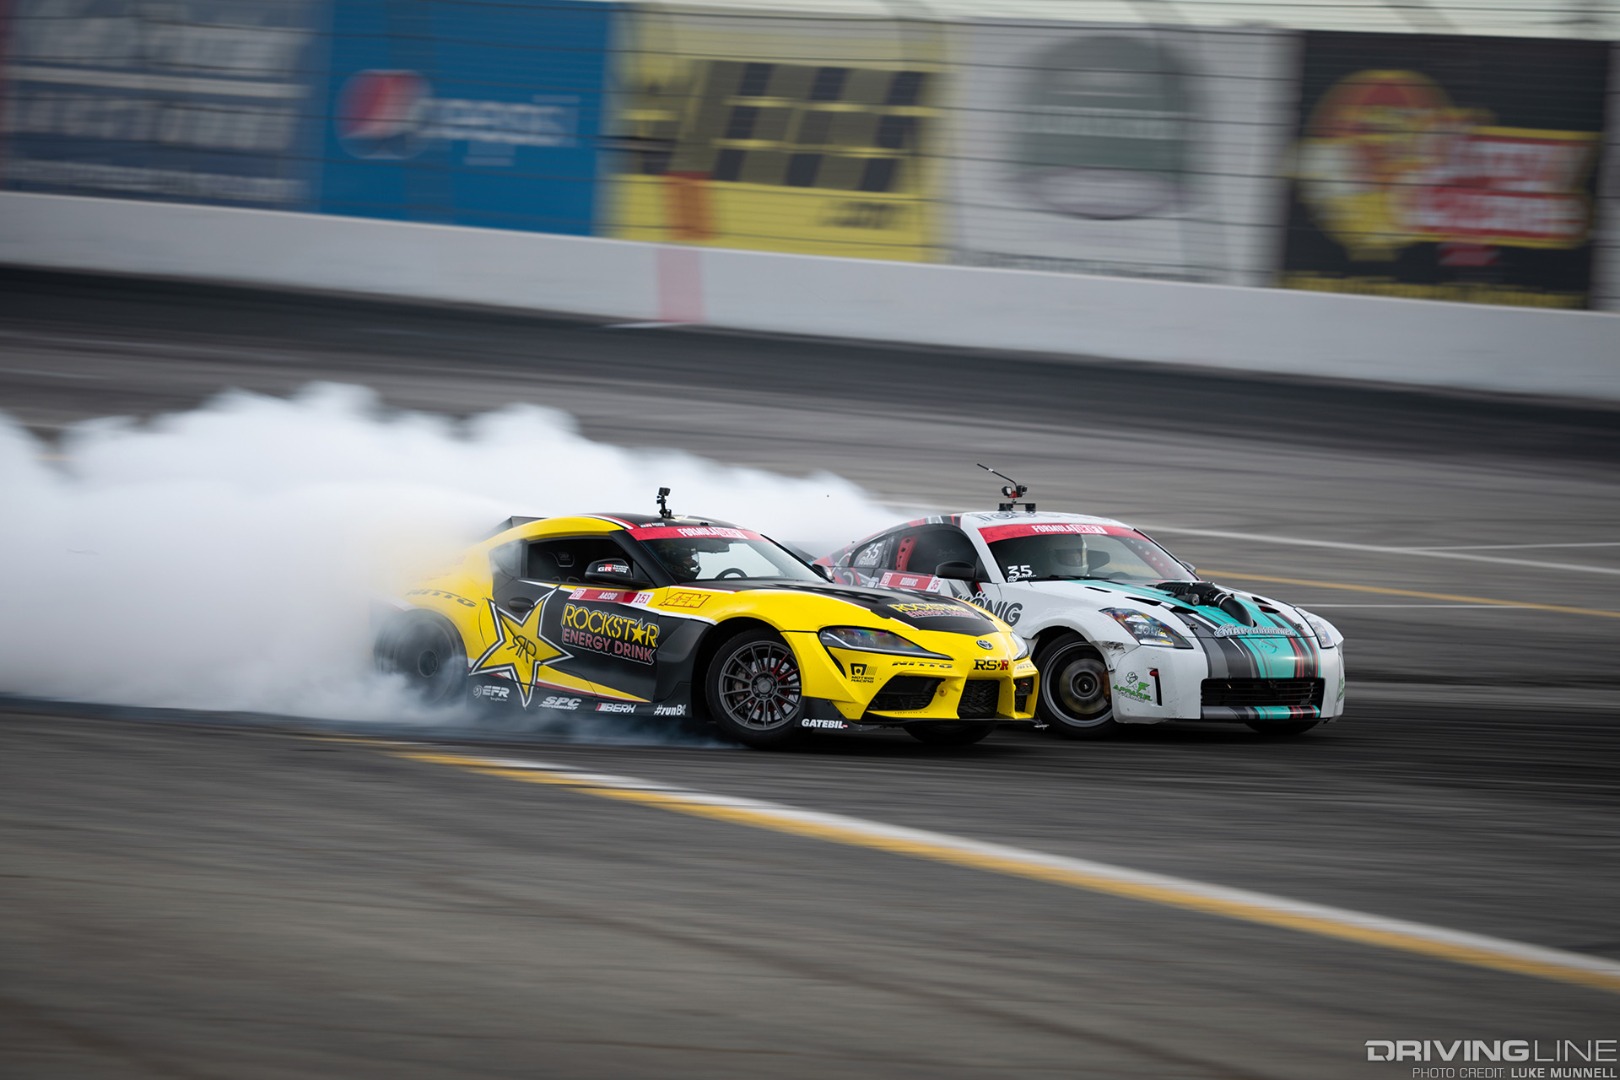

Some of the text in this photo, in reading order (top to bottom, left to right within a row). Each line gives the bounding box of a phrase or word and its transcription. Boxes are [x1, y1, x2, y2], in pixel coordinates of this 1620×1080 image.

[1031, 525, 1073, 534] FORMULA
[864, 543, 882, 559] 35
[1007, 565, 1033, 577] 35
[634, 593, 651, 604] 151
[562, 628, 654, 663] ENERGY DRINK
[482, 685, 511, 698] EFR
[542, 696, 582, 707] SPC
[801, 718, 844, 729] GATEBIL
